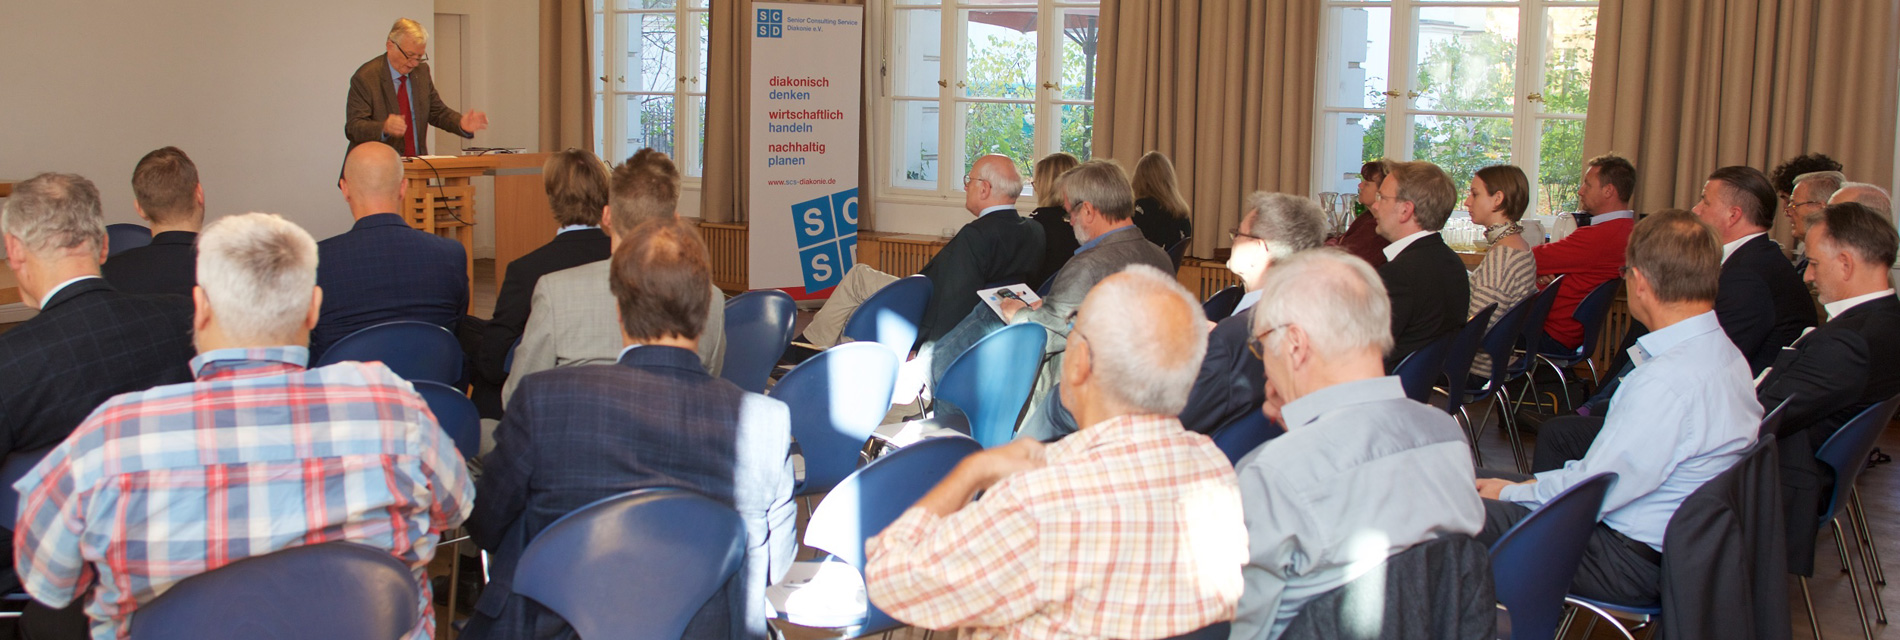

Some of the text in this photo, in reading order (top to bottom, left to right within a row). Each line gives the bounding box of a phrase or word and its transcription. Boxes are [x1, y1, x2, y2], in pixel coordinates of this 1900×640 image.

[769, 76, 829, 87] diakonisch
[769, 90, 810, 100] denken
[769, 109, 843, 120] wirtschaftlich
[769, 123, 812, 132] handeln
[768, 142, 825, 154] nachhaltig
[768, 156, 805, 167] planen
